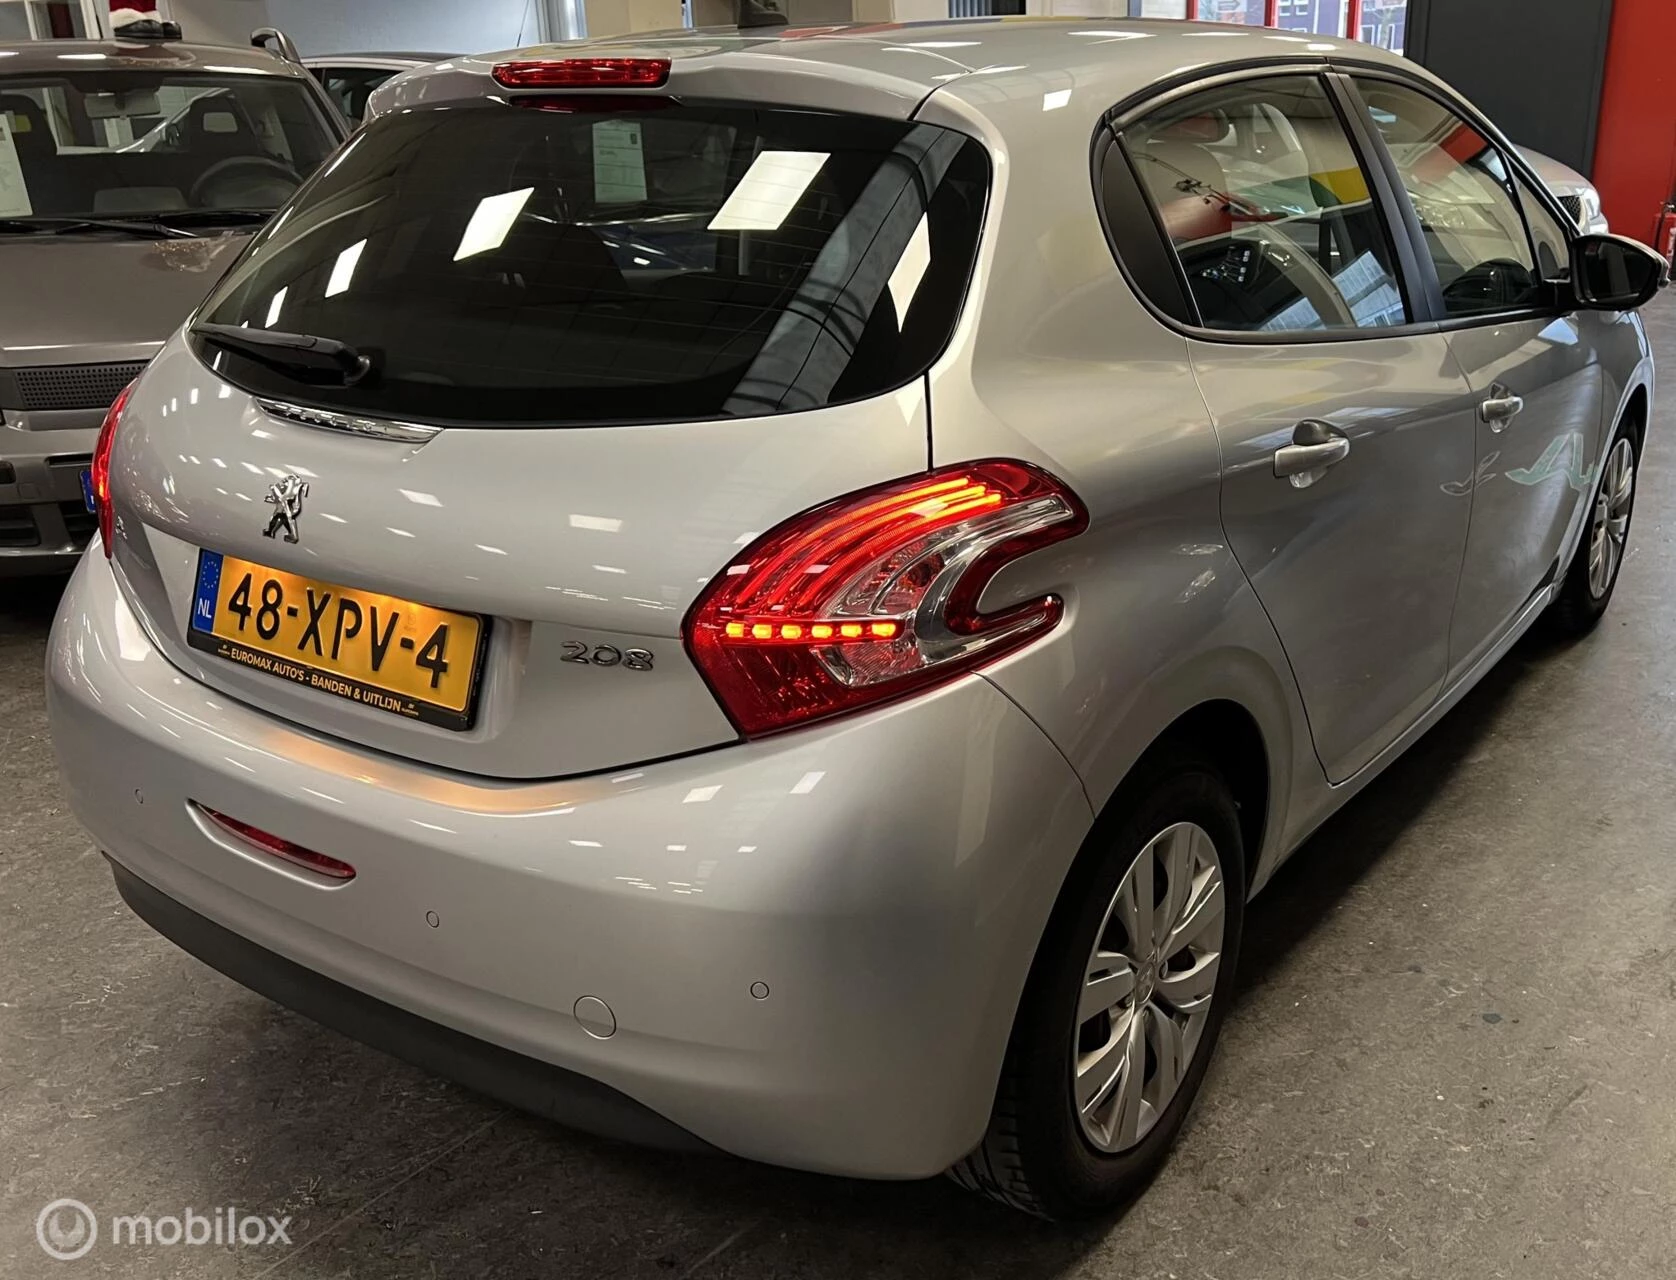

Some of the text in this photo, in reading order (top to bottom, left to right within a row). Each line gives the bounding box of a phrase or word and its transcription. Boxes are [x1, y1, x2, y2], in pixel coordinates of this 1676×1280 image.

[197, 597, 212, 619] NL
[228, 573, 450, 689] 48-XPV-4
[560, 640, 654, 671] 208
[231, 648, 273, 671] EUROMAX
[273, 662, 305, 681] AUTO'S
[311, 674, 352, 697] BANDEN
[353, 687, 360, 699] &
[363, 690, 401, 712] UITLIJN
